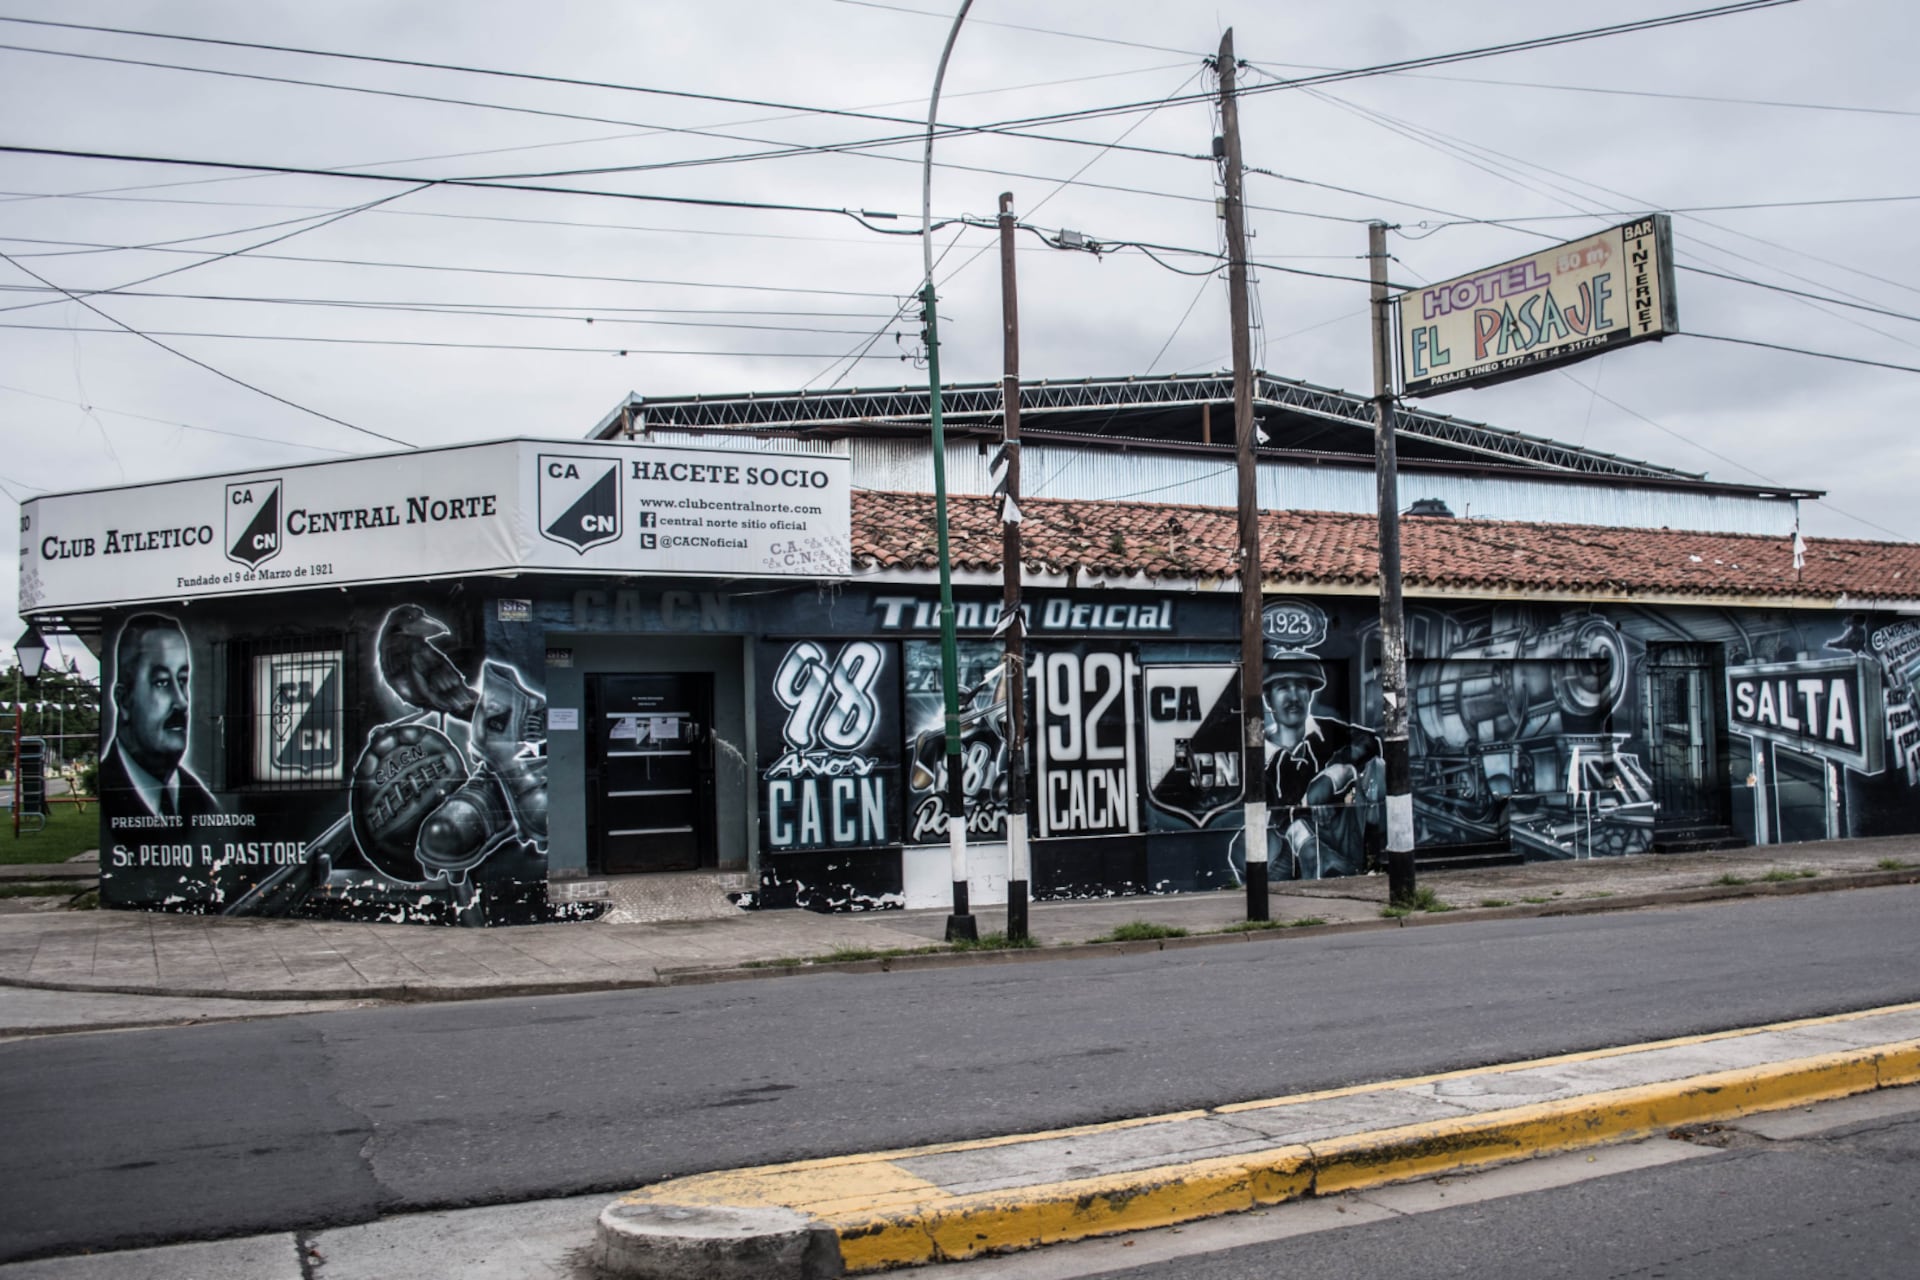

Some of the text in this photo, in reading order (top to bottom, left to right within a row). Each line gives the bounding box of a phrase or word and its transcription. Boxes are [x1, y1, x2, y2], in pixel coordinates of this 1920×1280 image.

[1624, 220, 1651, 241] BAR
[1423, 260, 1550, 321] HOTEL
[1632, 239, 1652, 333] INTERNET
[1412, 272, 1613, 378] EL PASAJE
[1430, 367, 1466, 386] PASAJE
[1468, 361, 1499, 377] TINEO
[1501, 355, 1525, 369] 1477
[1534, 350, 1548, 361] TE
[1568, 334, 1608, 352] 317794
[547, 463, 580, 480] CA
[632, 462, 829, 489] HACETE SOCIO
[232, 490, 254, 506] CA
[640, 498, 822, 515] www.clubcentralnorte.com
[286, 494, 498, 537] CENTRAL NORTE
[581, 515, 614, 532] CN
[660, 517, 807, 531] central norte sitio oficial
[253, 532, 277, 551] CN
[660, 536, 748, 549] @CACNoficial
[176, 564, 334, 588] Fundado el 9 de Marzo de 1921
[1267, 613, 1312, 635] 1923
[773, 641, 883, 750] 98
[1150, 687, 1202, 721] CA
[1736, 679, 1855, 745] SALTA
[1027, 652, 1140, 838] 1921
[1191, 751, 1239, 787] CN
[770, 777, 885, 846] CACN
[1049, 769, 1126, 831] CACN
[111, 813, 256, 828] PRESIDENTE FUNDADOR
[913, 796, 1008, 841] Paión
[140, 844, 193, 866] PEDRO
[224, 842, 307, 866] PASTORE
